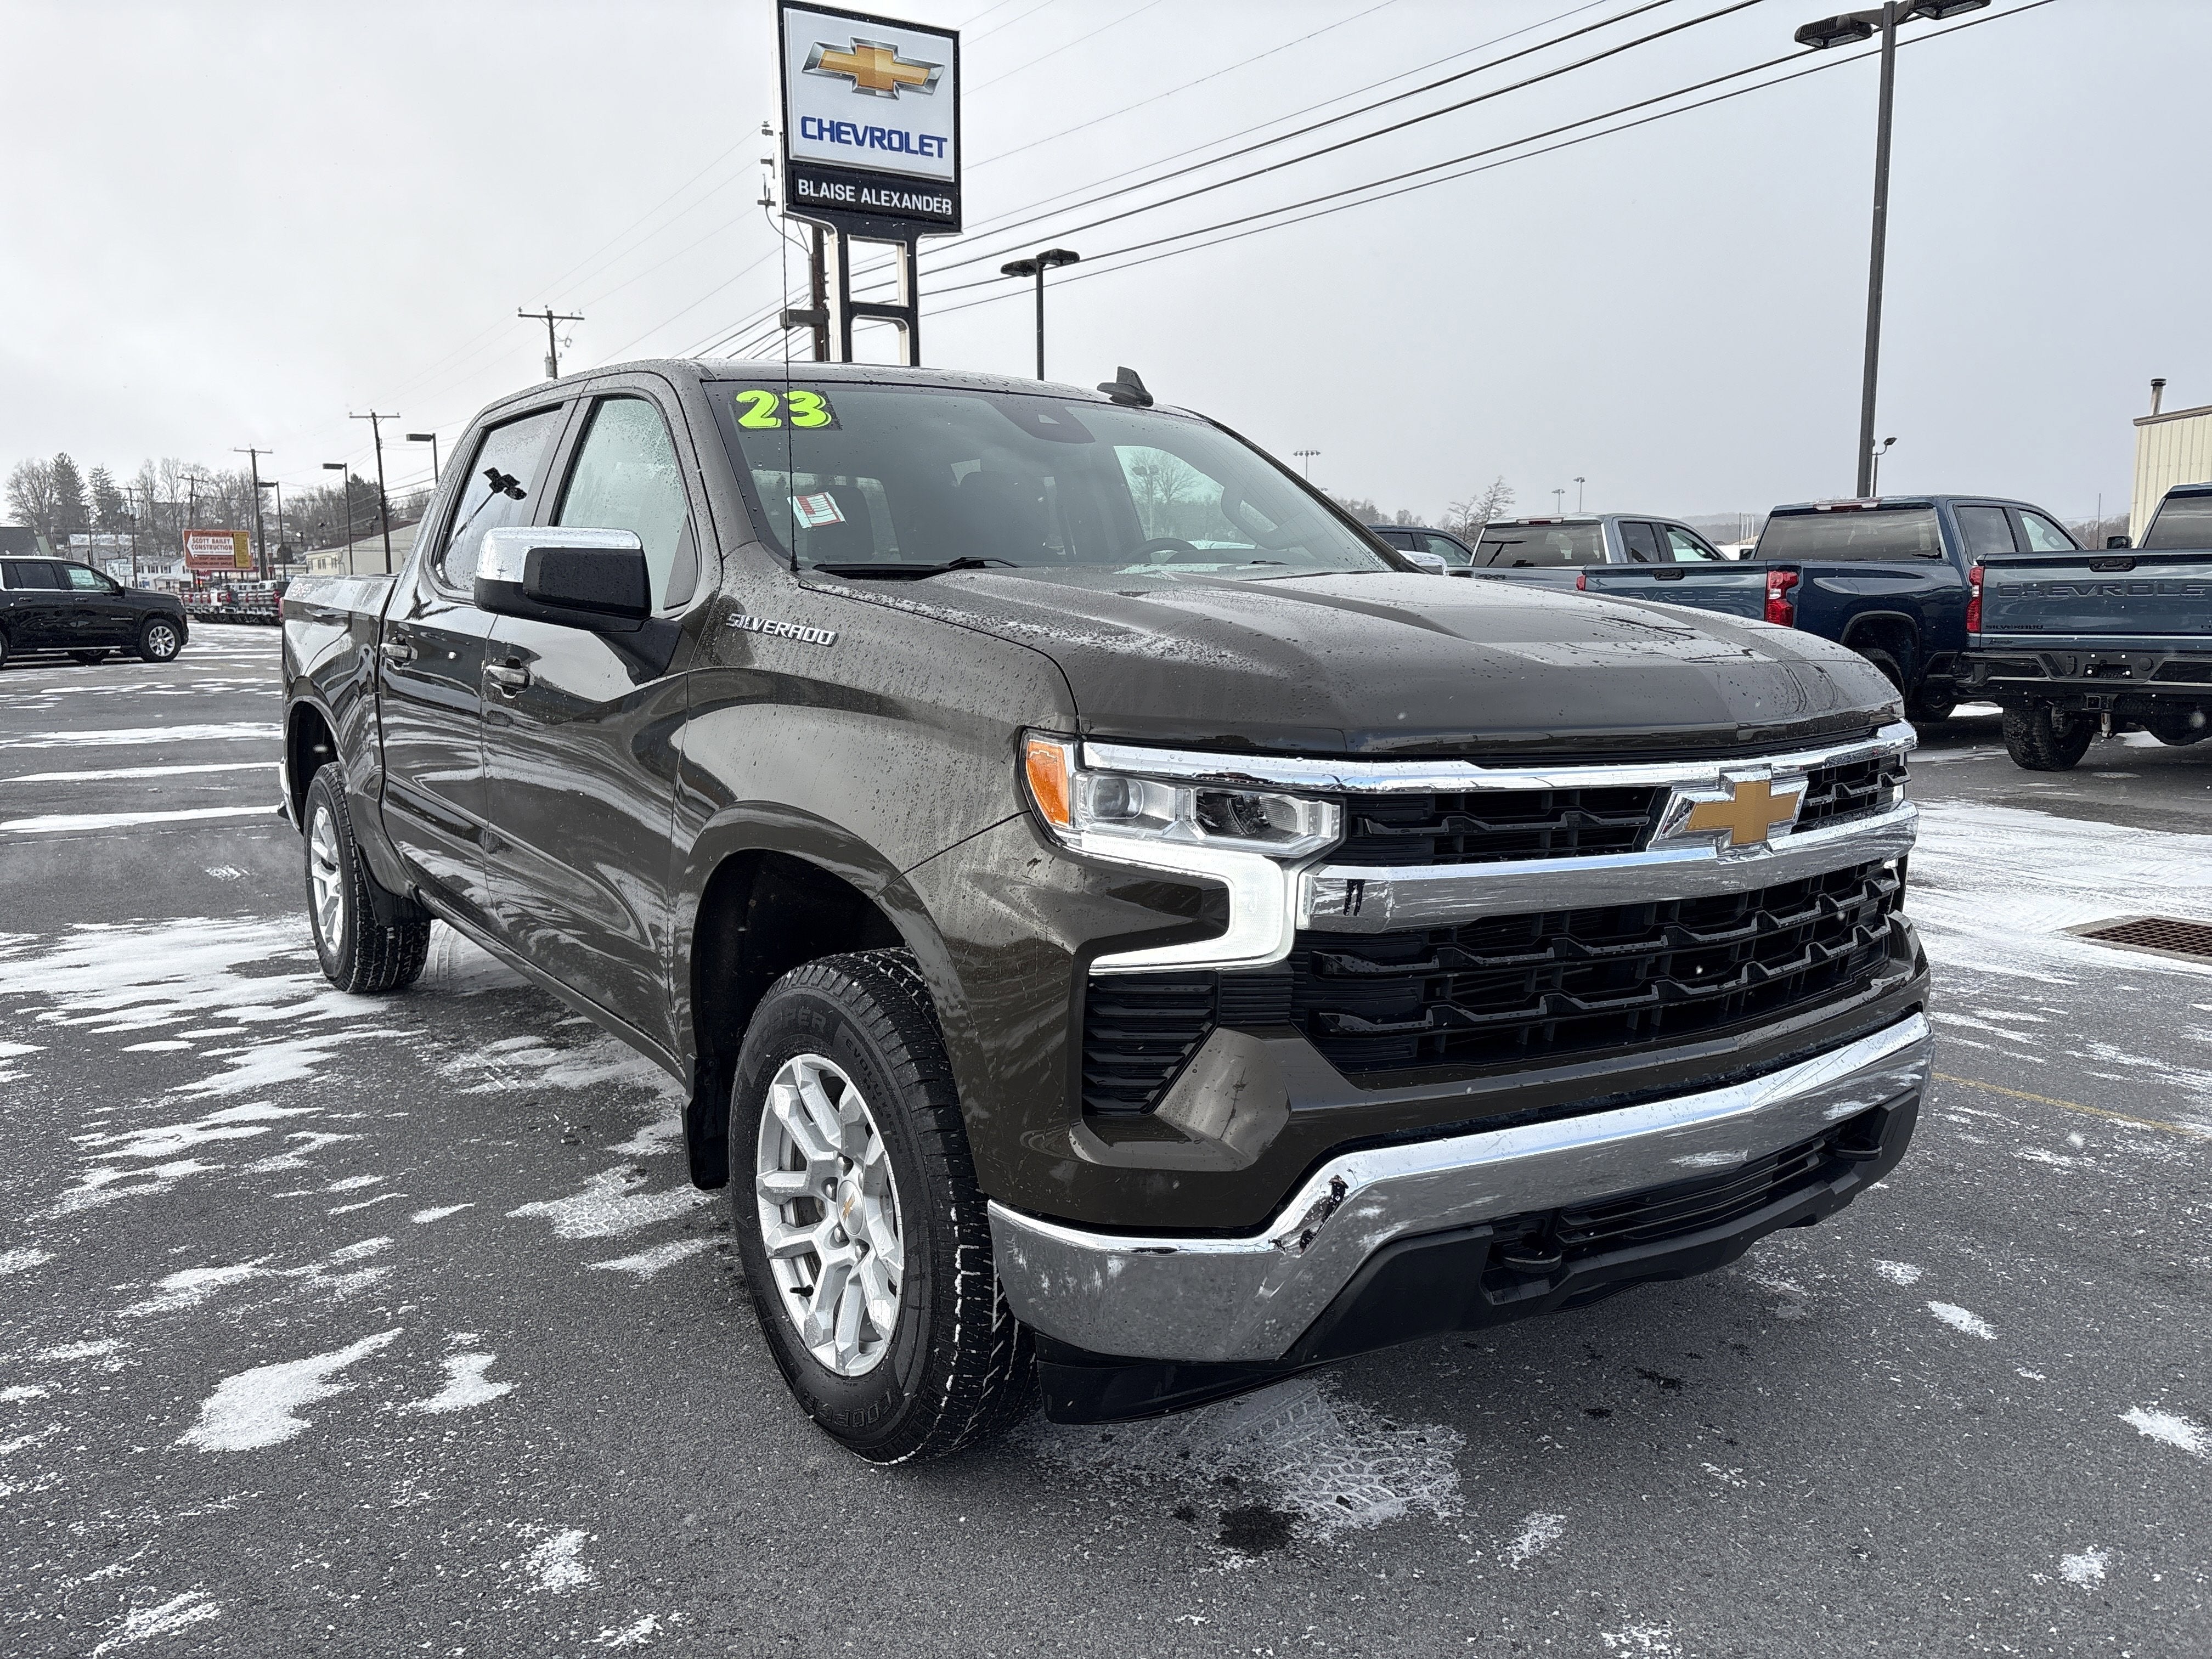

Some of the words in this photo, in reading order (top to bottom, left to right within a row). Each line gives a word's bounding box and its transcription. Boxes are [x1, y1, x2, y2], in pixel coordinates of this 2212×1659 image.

[801, 116, 947, 158] CHEVROLET
[798, 179, 856, 202] BLAISE
[861, 188, 952, 216] ALEXANDER
[736, 390, 832, 428] 23
[1998, 583, 2212, 598] CHEVROLE
[726, 613, 838, 646] SILVERADO
[846, 1039, 903, 1154] EVOLUTION
[803, 1388, 891, 1427] COOPER
